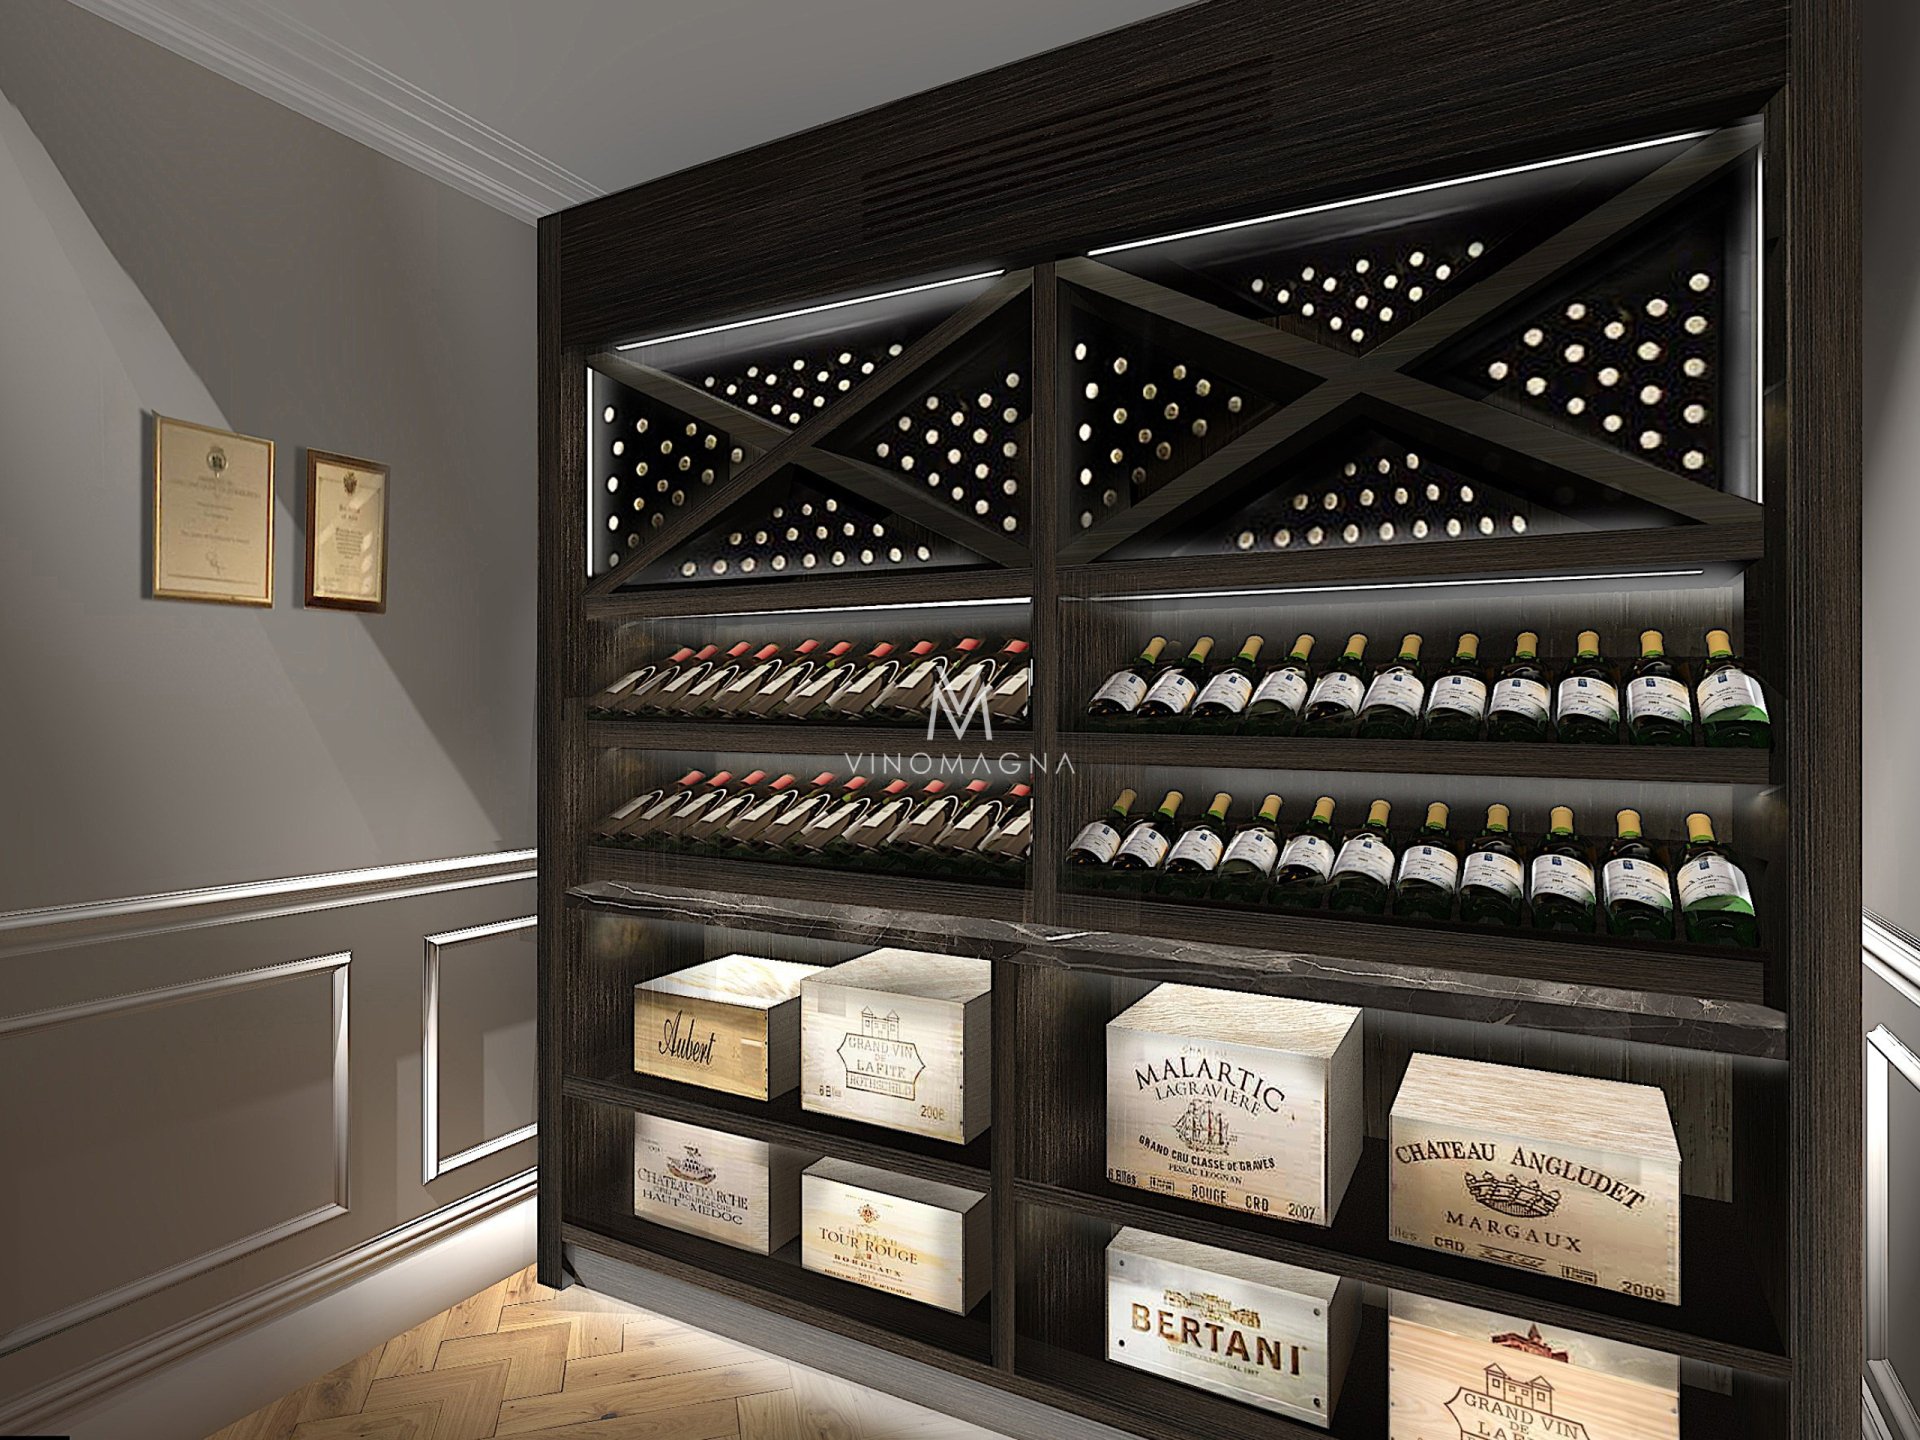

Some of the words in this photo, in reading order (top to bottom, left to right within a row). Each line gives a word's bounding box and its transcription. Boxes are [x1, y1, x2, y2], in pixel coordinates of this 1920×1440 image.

[659, 1010, 716, 1065] Aubert
[848, 1037, 889, 1054] GRAND
[893, 1044, 913, 1059] VIN
[857, 1059, 906, 1078] LAFITE
[850, 1075, 912, 1096] ROTHSCHILD
[1135, 1057, 1285, 1112] MALARTIC
[1155, 1081, 1261, 1116] LAGRAVIERE
[1139, 1135, 1169, 1156] GRAND
[1171, 1150, 1188, 1163] CRU
[1191, 1155, 1225, 1171] CLASSE
[1239, 1157, 1276, 1172] GRAVES
[638, 1168, 694, 1194] CHATEAU
[1396, 1139, 1496, 1164] CHATEAU
[1510, 1147, 1645, 1210] ANGLUDET
[1191, 1184, 1227, 1203] ROUGE
[1288, 1202, 1316, 1220] 2007
[818, 1227, 859, 1249] TOUR
[865, 1242, 918, 1266] ROUGE
[1446, 1211, 1582, 1253] MARGAUX
[834, 1253, 902, 1278] BORDEAUX
[1621, 1280, 1666, 1301] 2009
[1131, 1302, 1300, 1376] BERTANI
[1464, 1392, 1534, 1425] GRAND
[1541, 1416, 1579, 1440] VIN
[1509, 1420, 1530, 1435] DE
